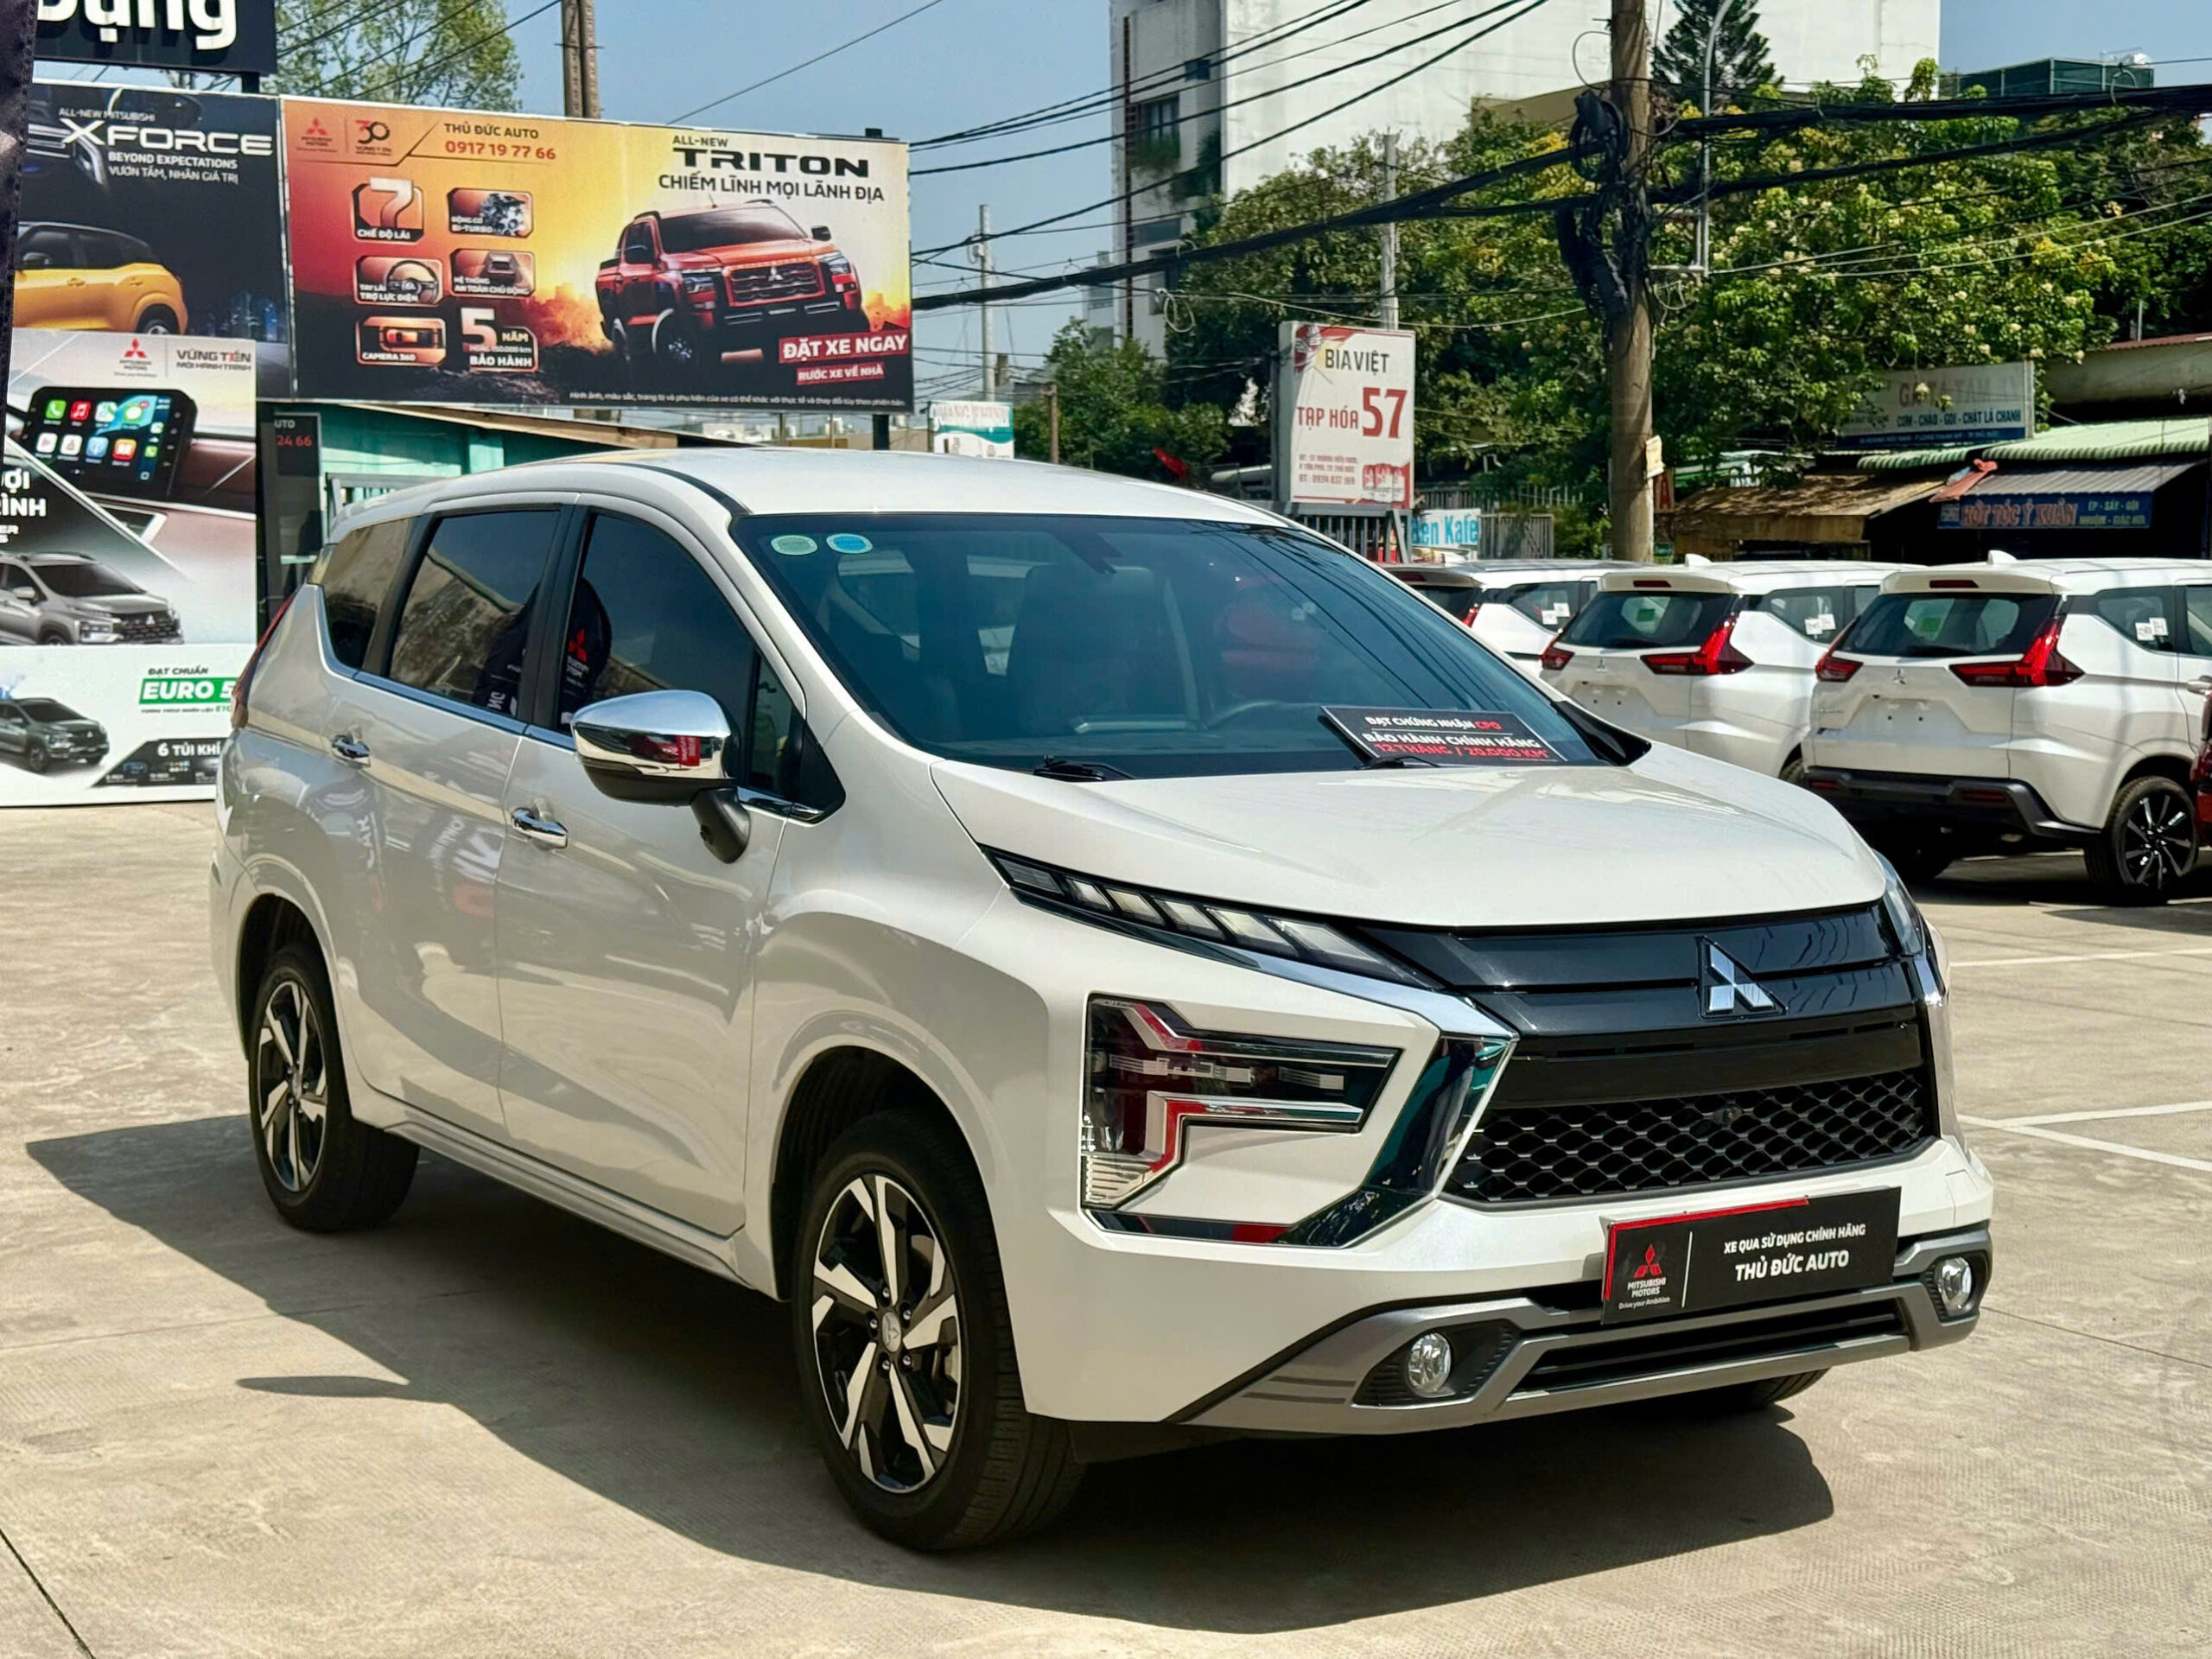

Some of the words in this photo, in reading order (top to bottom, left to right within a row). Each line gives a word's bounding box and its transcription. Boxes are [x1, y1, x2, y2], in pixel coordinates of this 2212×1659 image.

[37, 0, 237, 50] ụng
[59, 107, 102, 118] ALL-NEW
[104, 110, 156, 122] MITSUBISHI
[60, 118, 273, 156] XFORCE
[443, 120, 471, 135] THỦ
[474, 122, 501, 137] ĐỨC
[504, 127, 539, 139] AUTO
[445, 140, 486, 155] 0917
[490, 143, 506, 156] 19
[511, 145, 531, 158] 77
[536, 148, 556, 160] 66
[672, 135, 728, 148] ALL-NEW
[107, 151, 155, 163] BEYOND
[156, 154, 238, 169] EXPECTATIONS
[672, 147, 868, 178] TRITON
[201, 170, 220, 181] GIÁ
[221, 172, 238, 185] TRỊ
[658, 172, 715, 192] CHIẾM
[721, 175, 761, 194] LĨNH
[766, 181, 799, 200] MỌI
[804, 180, 850, 200] LÃNH
[855, 186, 885, 205] ĐỊA
[369, 177, 414, 229] 7
[357, 228, 378, 238] CHẾ
[378, 228, 393, 240] ĐỘ
[394, 230, 410, 239] LÁI
[461, 307, 497, 352] 5
[502, 331, 529, 342] NĂM
[176, 348, 218, 361] VỮNG
[783, 337, 822, 361] ĐẶT
[825, 338, 850, 356] XE
[855, 334, 907, 353] NGAY
[361, 352, 398, 361] CAMERA
[469, 352, 496, 365] BẢO
[497, 354, 533, 367] HÀNH
[1325, 348, 1351, 372] BIA
[1352, 350, 1389, 376] VIỆT
[798, 367, 828, 381] RƯỚC
[830, 368, 843, 378] XE
[845, 365, 859, 378] VỀ
[860, 364, 884, 377] NHÀ
[1297, 406, 1325, 430] TẠP
[1329, 405, 1358, 429] HÓA
[1362, 386, 1408, 439] 57
[1996, 410, 2021, 423] CHANH
[296, 435, 313, 447] 66
[2, 467, 30, 493] ỢI
[0, 493, 47, 517] ÌNH
[148, 668, 170, 677] ĐẠT
[172, 664, 209, 675] CHUẨN
[142, 680, 215, 700] EURO
[1365, 717, 1392, 727] ĐẠT
[1392, 716, 1439, 727] CHỨNG
[1437, 719, 1476, 730] NHẬN
[1474, 721, 1502, 730] CPO
[1362, 731, 1399, 742] BẢO
[1397, 733, 1446, 745] HÀNH
[1445, 734, 1497, 747] CHÍNH
[1494, 736, 1541, 748] HÃNG
[157, 742, 169, 757] 6
[197, 741, 221, 756] KHÍ
[1373, 743, 1396, 753] 12
[1394, 743, 1453, 754] THÁNG
[1724, 1241, 1737, 1254] XE
[1738, 1237, 1759, 1253] QUA
[1761, 1231, 1776, 1249] SỬ
[1777, 1231, 1804, 1249] DỤNG
[1806, 1226, 1837, 1243] CHÍNH
[1838, 1223, 1866, 1238] HÃNG
[1735, 1255, 1768, 1281] THỦ
[1770, 1253, 1804, 1276] ĐỨC
[1805, 1249, 1849, 1272] AUTO
[1627, 1277, 1667, 1291] MITSUBISHI
[1631, 1286, 1660, 1298] MOTORS
[1633, 1300, 1646, 1309] your
[1646, 1297, 1671, 1306] Ambition
